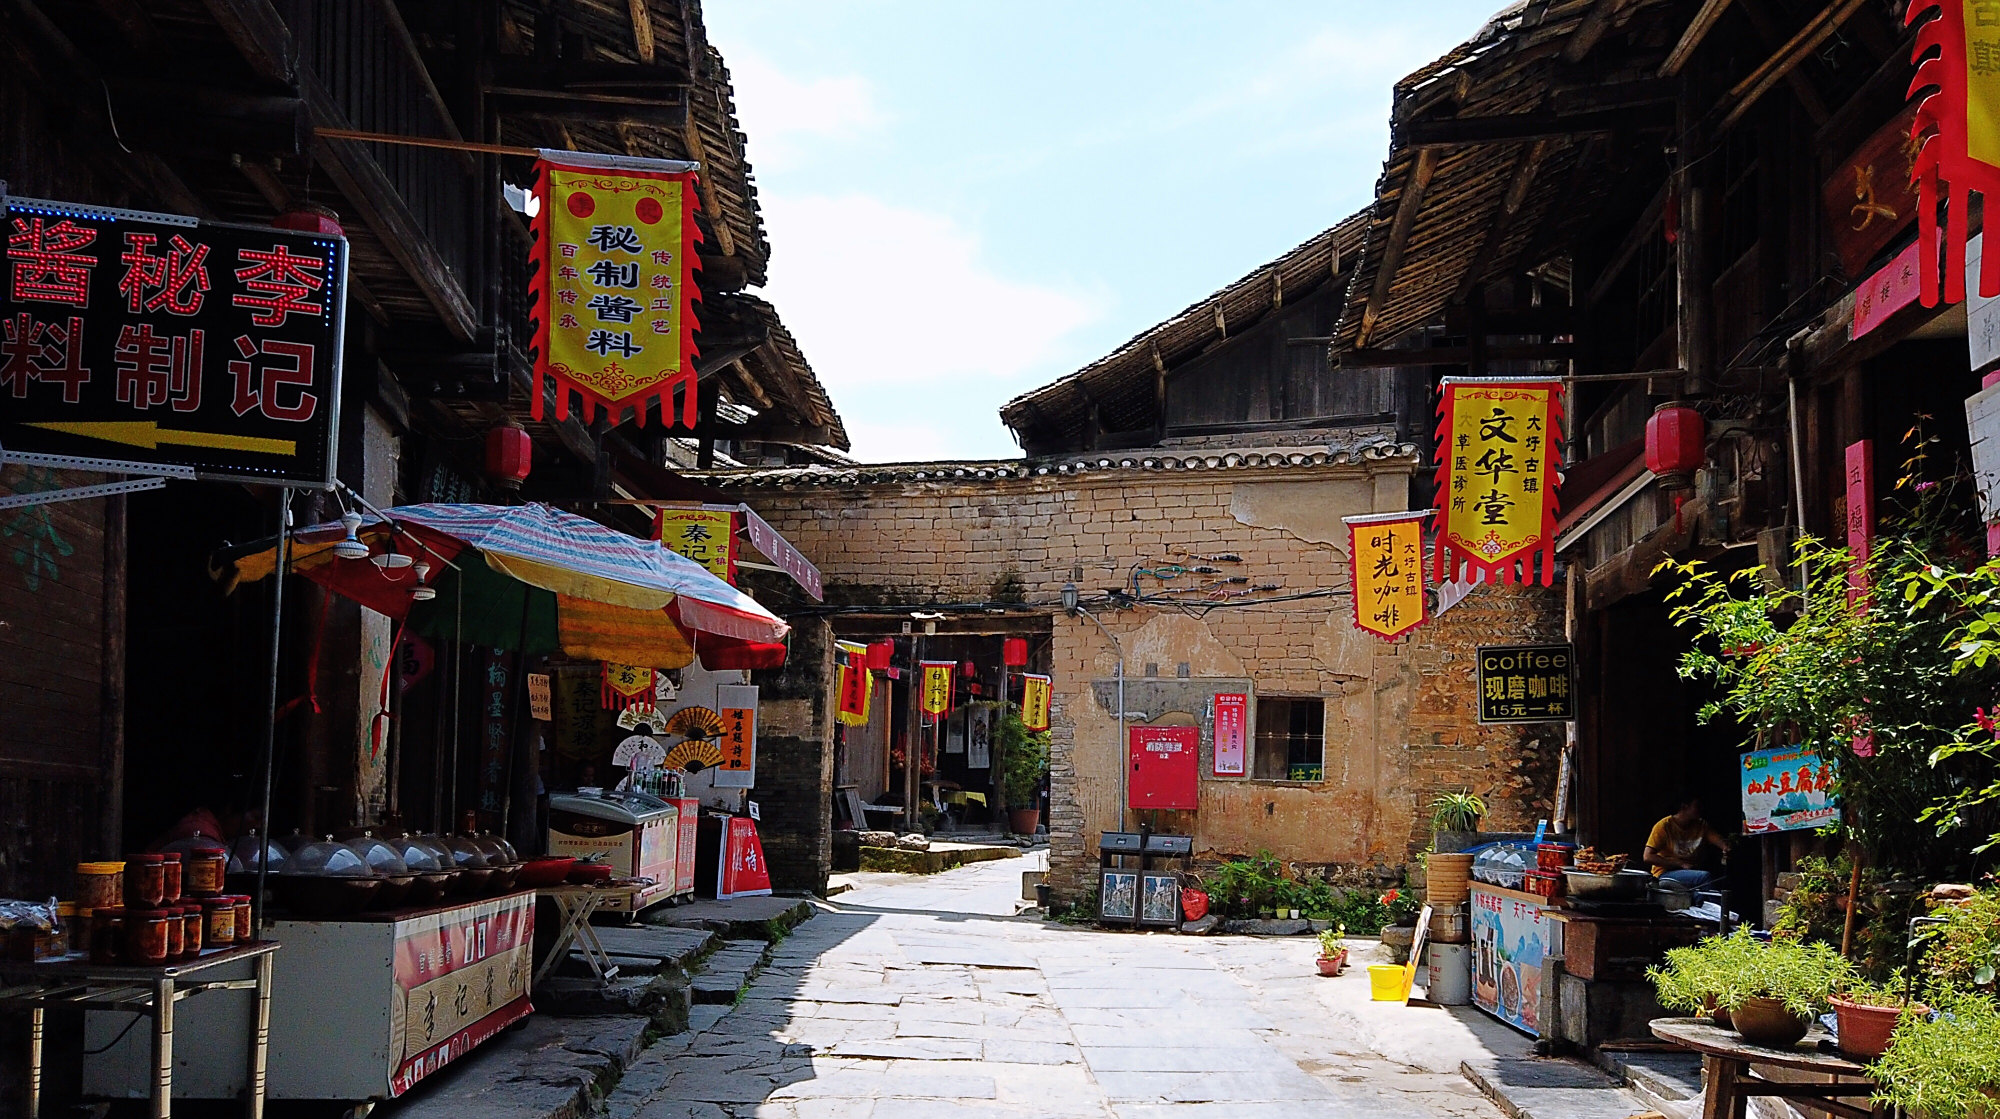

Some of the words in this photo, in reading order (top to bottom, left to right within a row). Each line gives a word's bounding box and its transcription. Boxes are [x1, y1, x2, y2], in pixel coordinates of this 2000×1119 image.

[0, 218, 98, 403] 酱料
[114, 234, 211, 412] 秘制
[558, 243, 578, 329] 百年传承
[585, 224, 643, 359] 秘制酱料
[650, 250, 673, 335] 传统工艺
[228, 245, 324, 422] 李记
[1452, 434, 1470, 514] 草医诊所
[1473, 408, 1519, 526] 文华堂
[1523, 414, 1542, 493] 大圩古镇
[680, 524, 712, 570] 秦记
[1370, 529, 1401, 629] 时光咖啡
[1404, 543, 1418, 597] 大圩古镇
[929, 670, 942, 708] 白兴和
[1484, 651, 1567, 671] coffee
[1485, 674, 1569, 701] 现磨咖啡
[1490, 703, 1564, 717] 15元一杯
